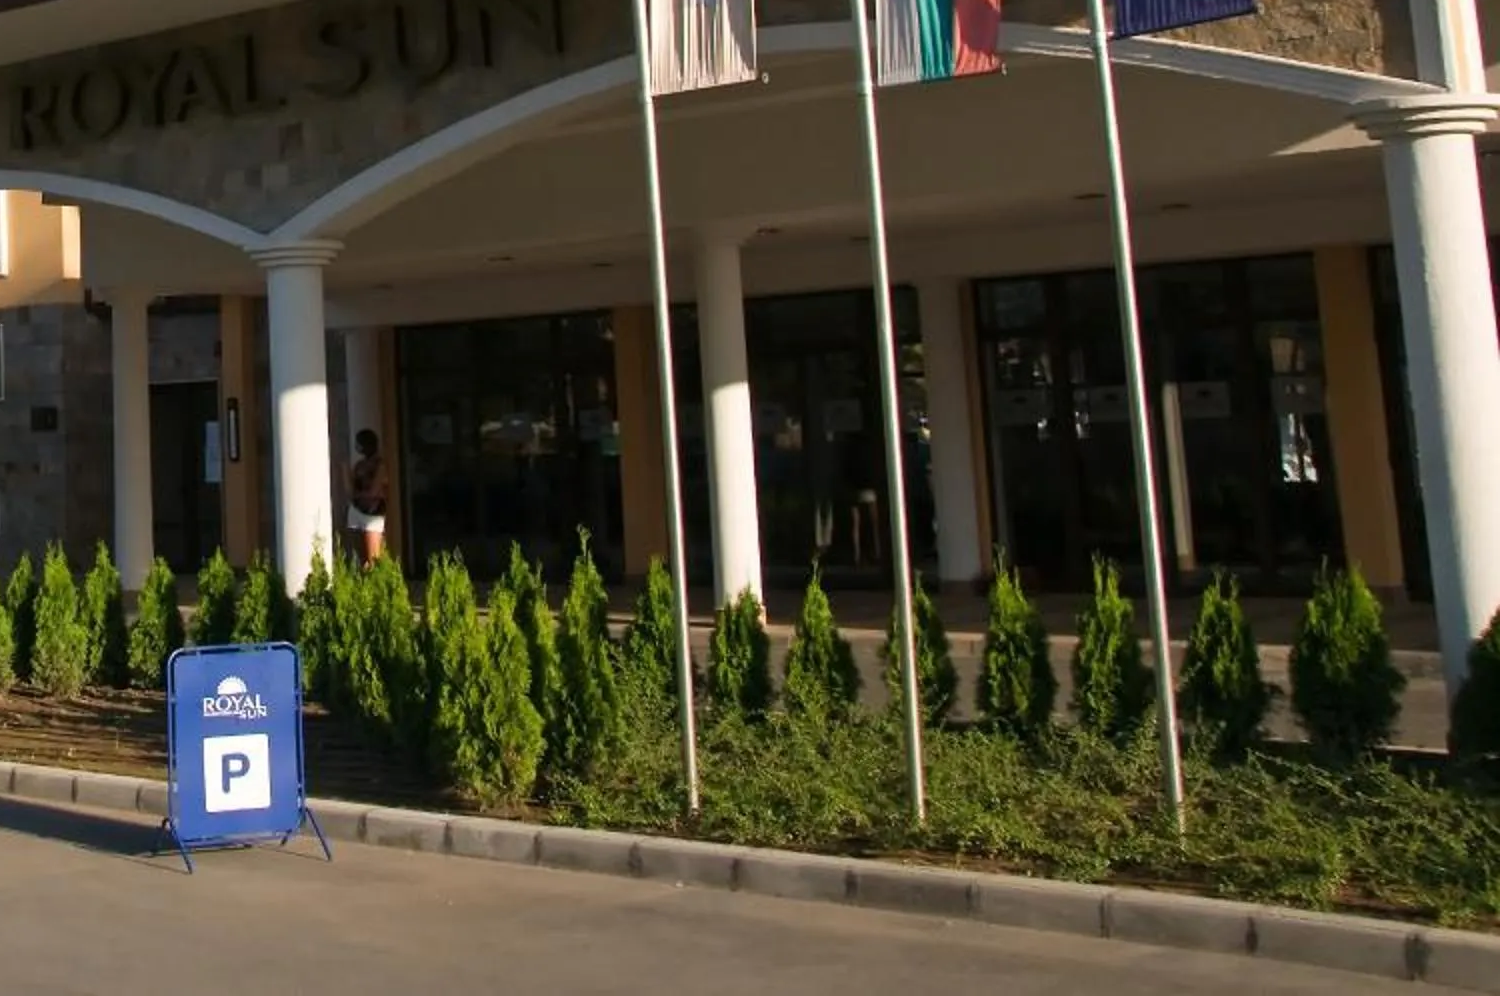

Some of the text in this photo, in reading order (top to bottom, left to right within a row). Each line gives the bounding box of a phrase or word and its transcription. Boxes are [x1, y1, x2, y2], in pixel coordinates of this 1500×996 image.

[13, 33, 287, 152] ROYAL
[204, 693, 264, 713] ROYAL
[239, 705, 267, 719] SUN
[221, 752, 250, 793] P
